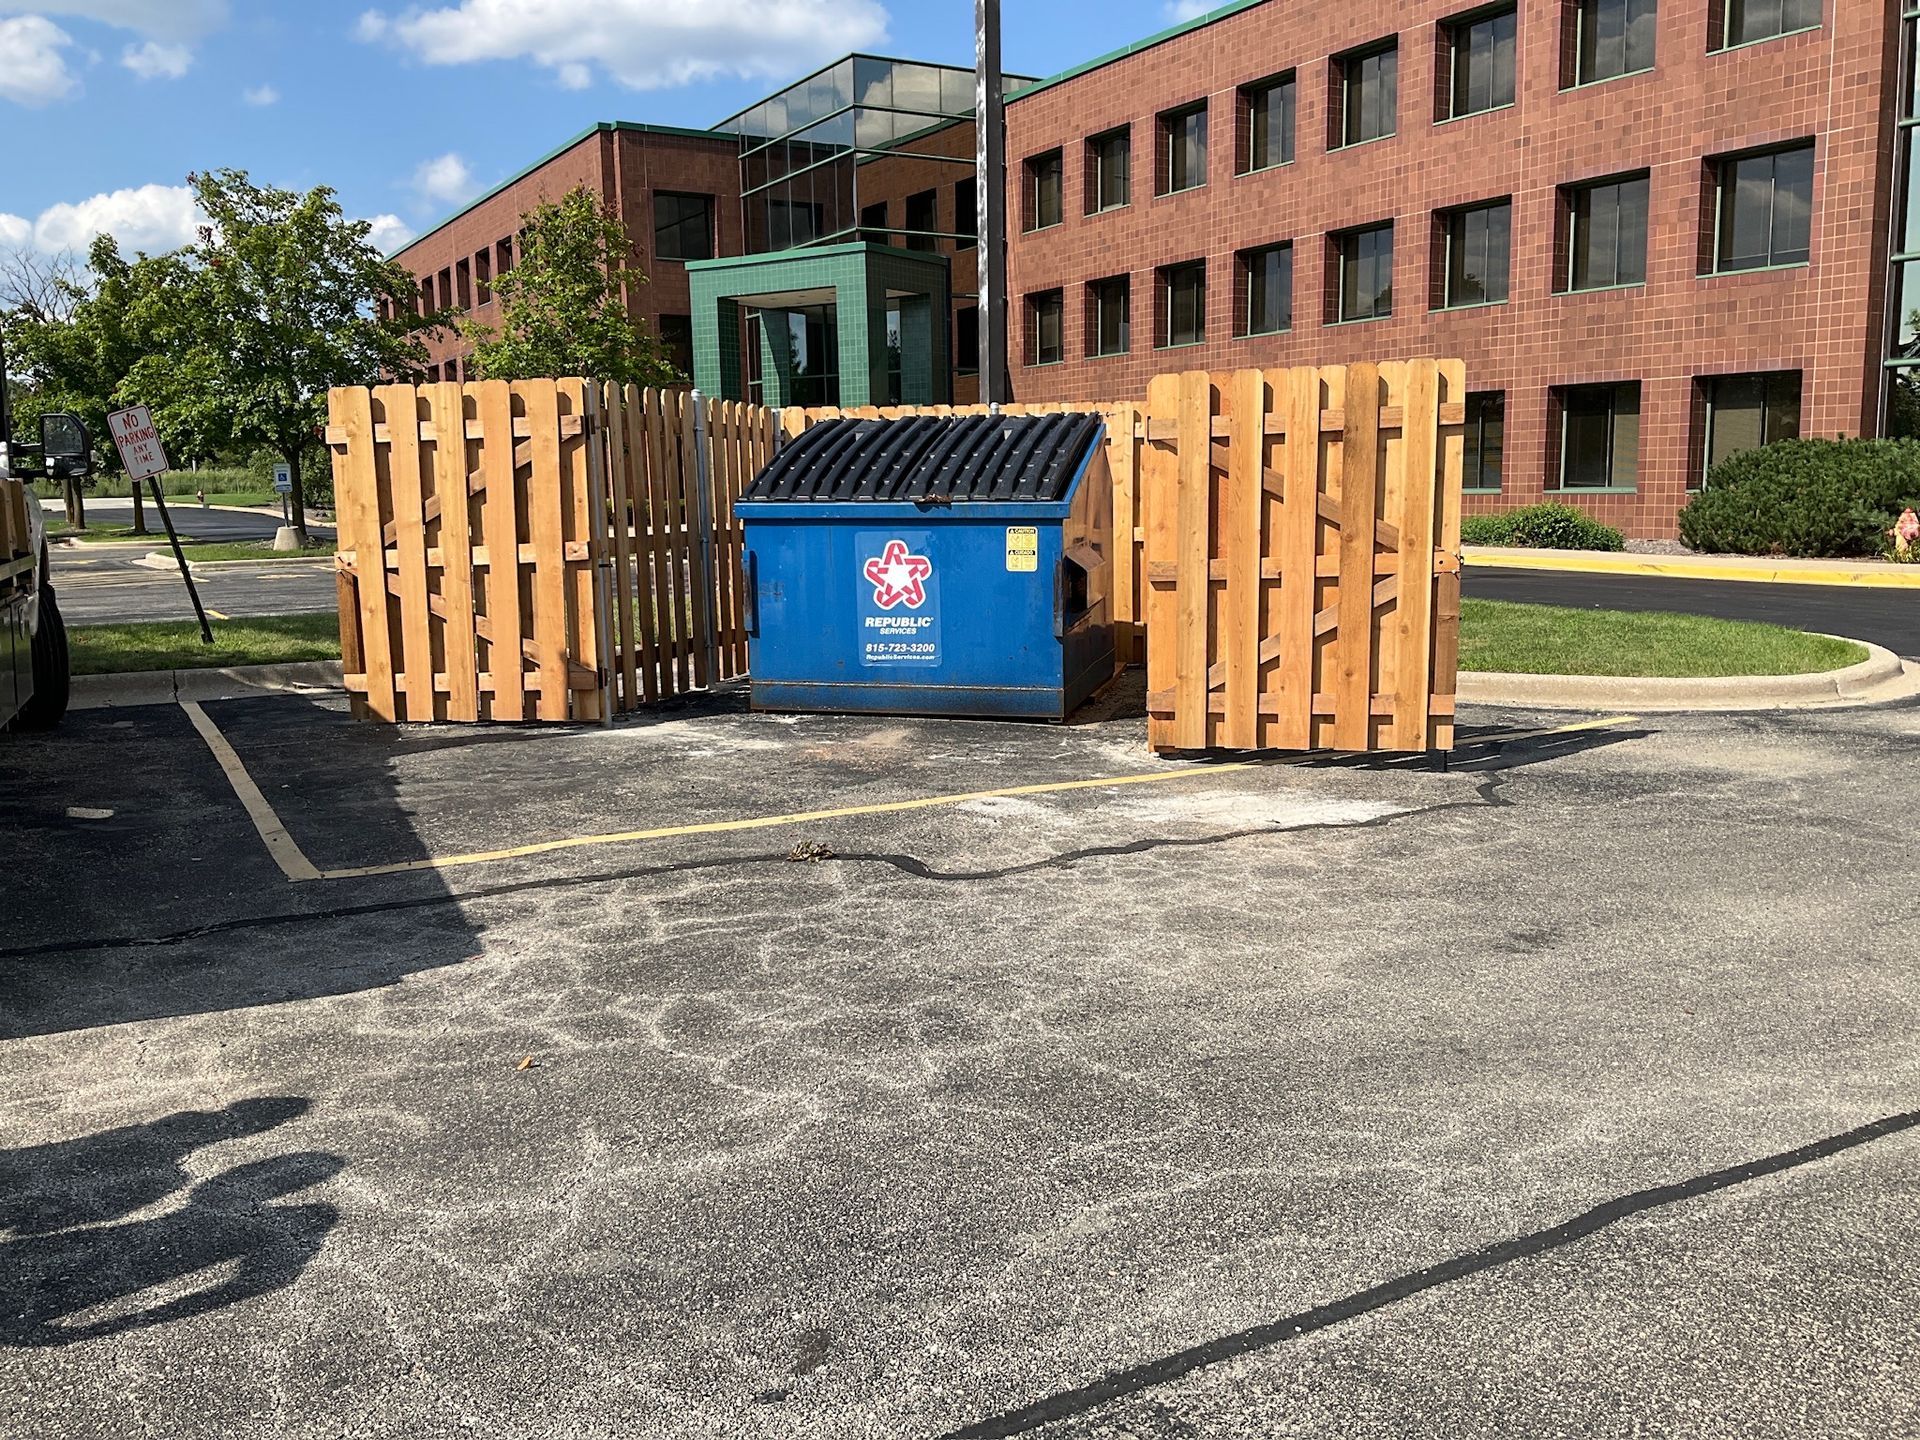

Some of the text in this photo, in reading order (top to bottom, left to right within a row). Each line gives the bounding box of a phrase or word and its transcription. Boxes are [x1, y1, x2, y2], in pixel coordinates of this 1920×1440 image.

[122, 415, 138, 429] NO
[118, 427, 154, 447] PARKING
[134, 443, 148, 455] ANY
[134, 452, 154, 464] TIME
[879, 627, 917, 635] SERVICES
[865, 643, 935, 652] 815-723-3200
[866, 653, 935, 661] RepublicServices.com
